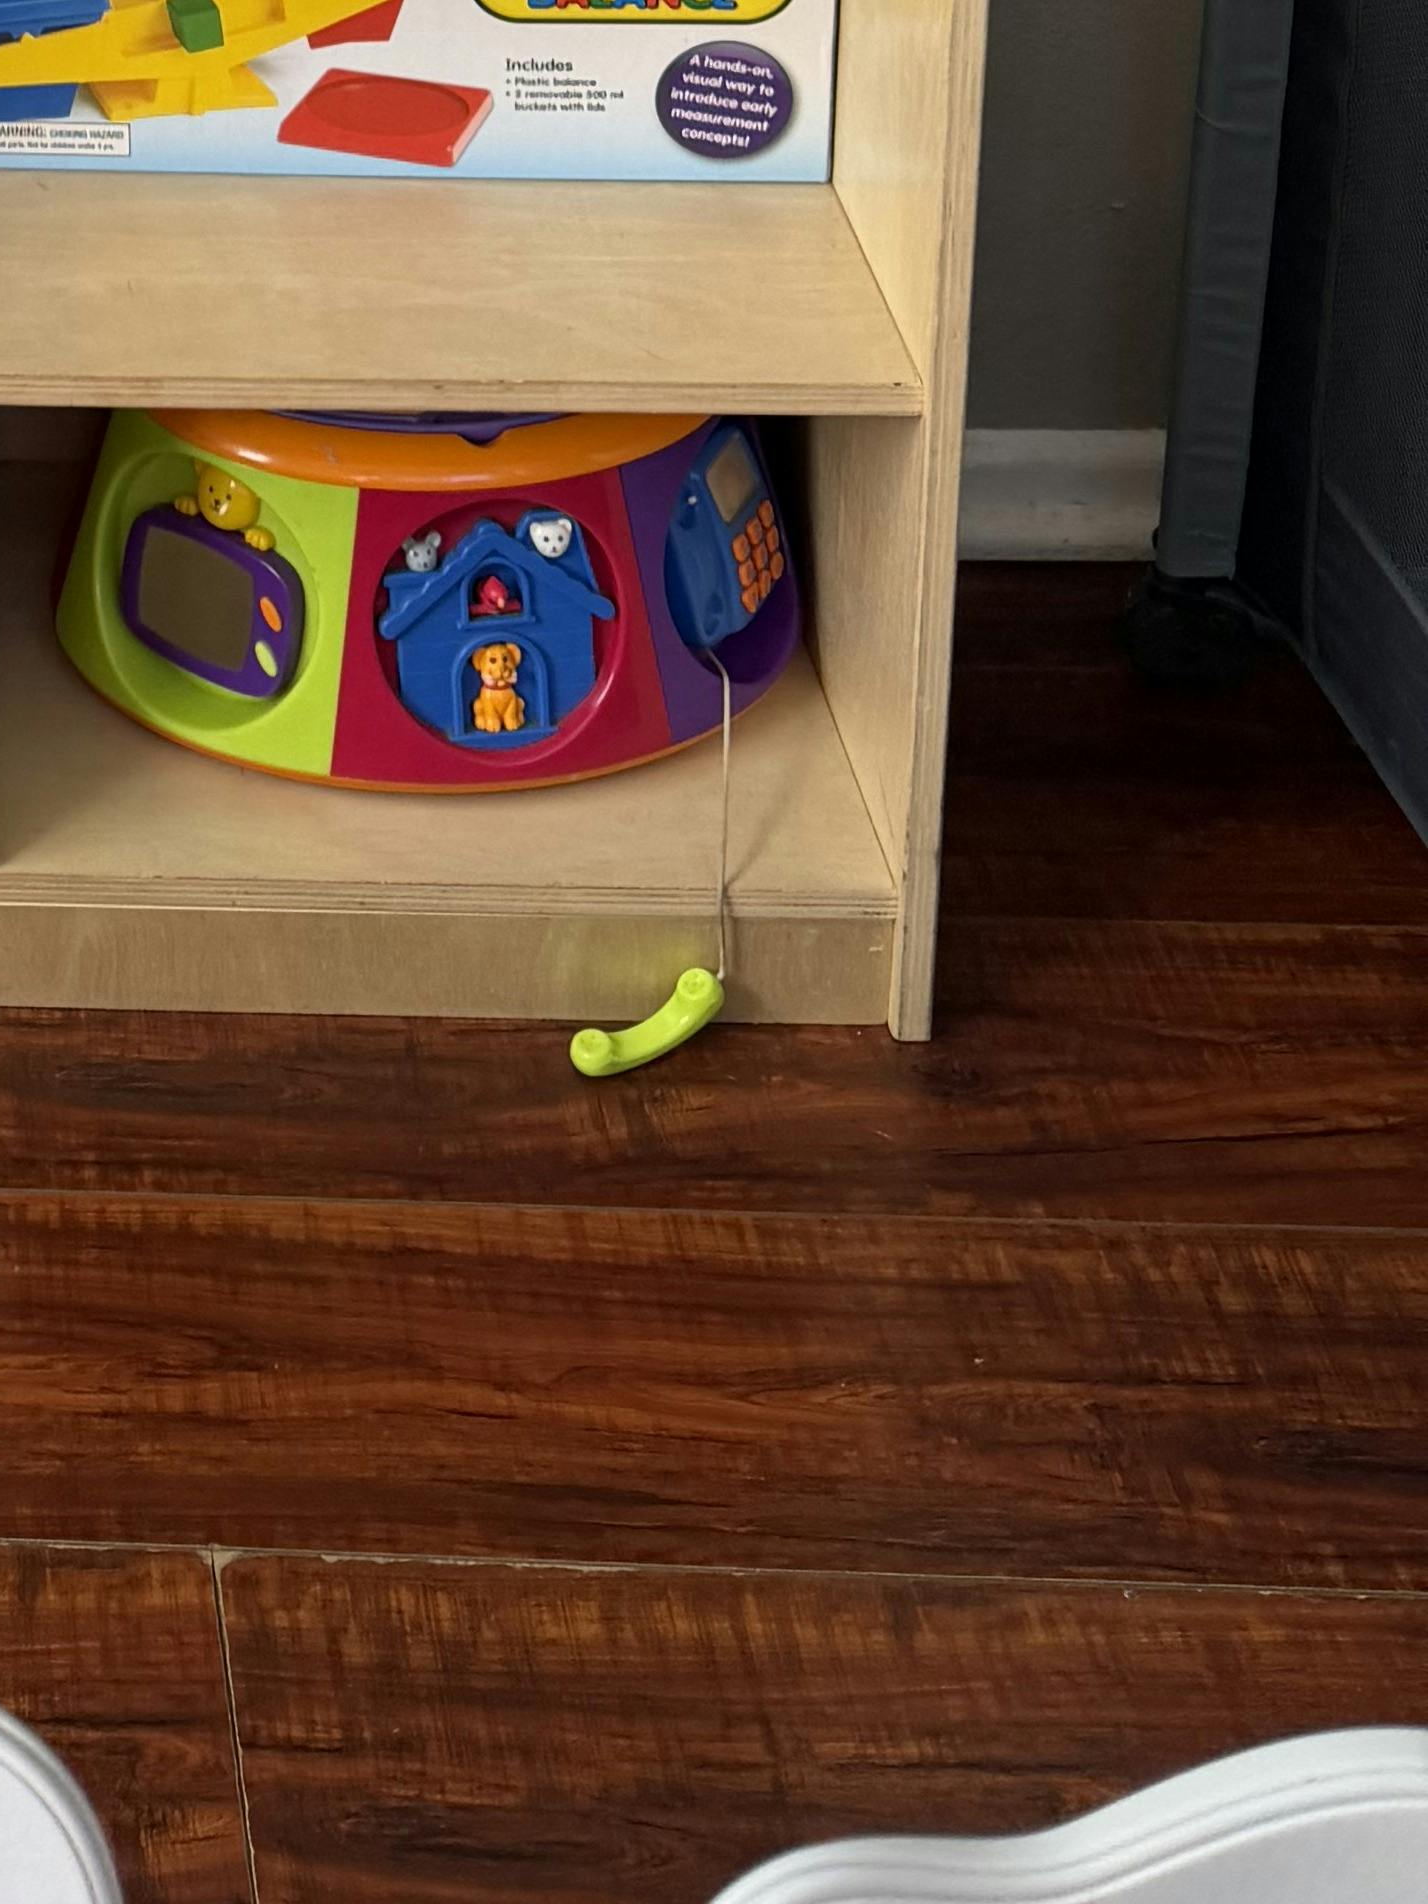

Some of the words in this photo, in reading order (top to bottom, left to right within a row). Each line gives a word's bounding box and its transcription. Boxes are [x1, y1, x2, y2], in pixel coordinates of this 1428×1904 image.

[506, 57, 573, 72] Includes
[689, 54, 701, 67] A
[514, 76, 550, 86] Plastic
[553, 76, 597, 87] balance
[682, 71, 724, 89] visual
[725, 79, 756, 97] way
[759, 84, 775, 98] to
[560, 102, 584, 112] with
[670, 87, 738, 111] introduce
[741, 99, 778, 119] early
[671, 108, 769, 132] measurement
[681, 127, 752, 149] concepts!
